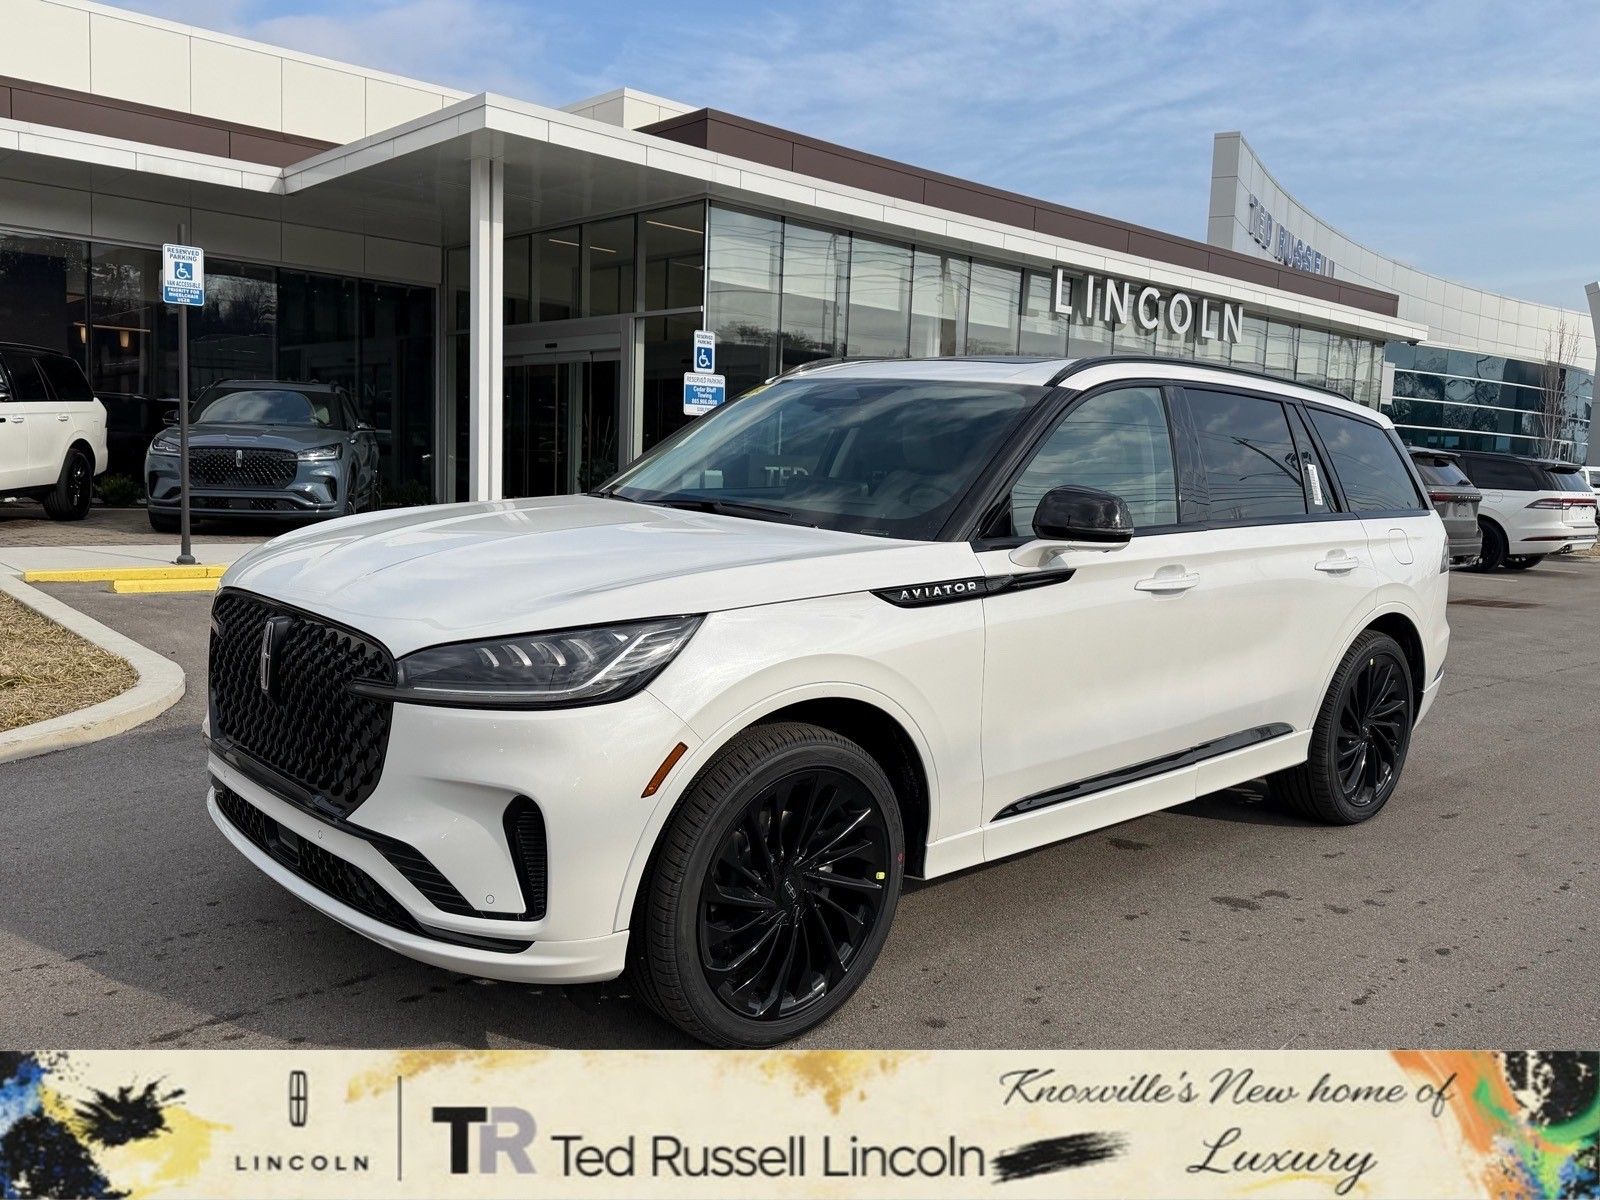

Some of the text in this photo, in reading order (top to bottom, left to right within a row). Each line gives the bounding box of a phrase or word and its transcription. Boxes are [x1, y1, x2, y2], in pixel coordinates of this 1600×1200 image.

[1249, 194, 1272, 250] TED
[167, 247, 200, 256] RESERVED
[169, 254, 198, 262] PARKING
[1054, 267, 1244, 344] LINCOLN
[696, 333, 714, 341] RESERVED
[900, 581, 977, 600] AVIATOR
